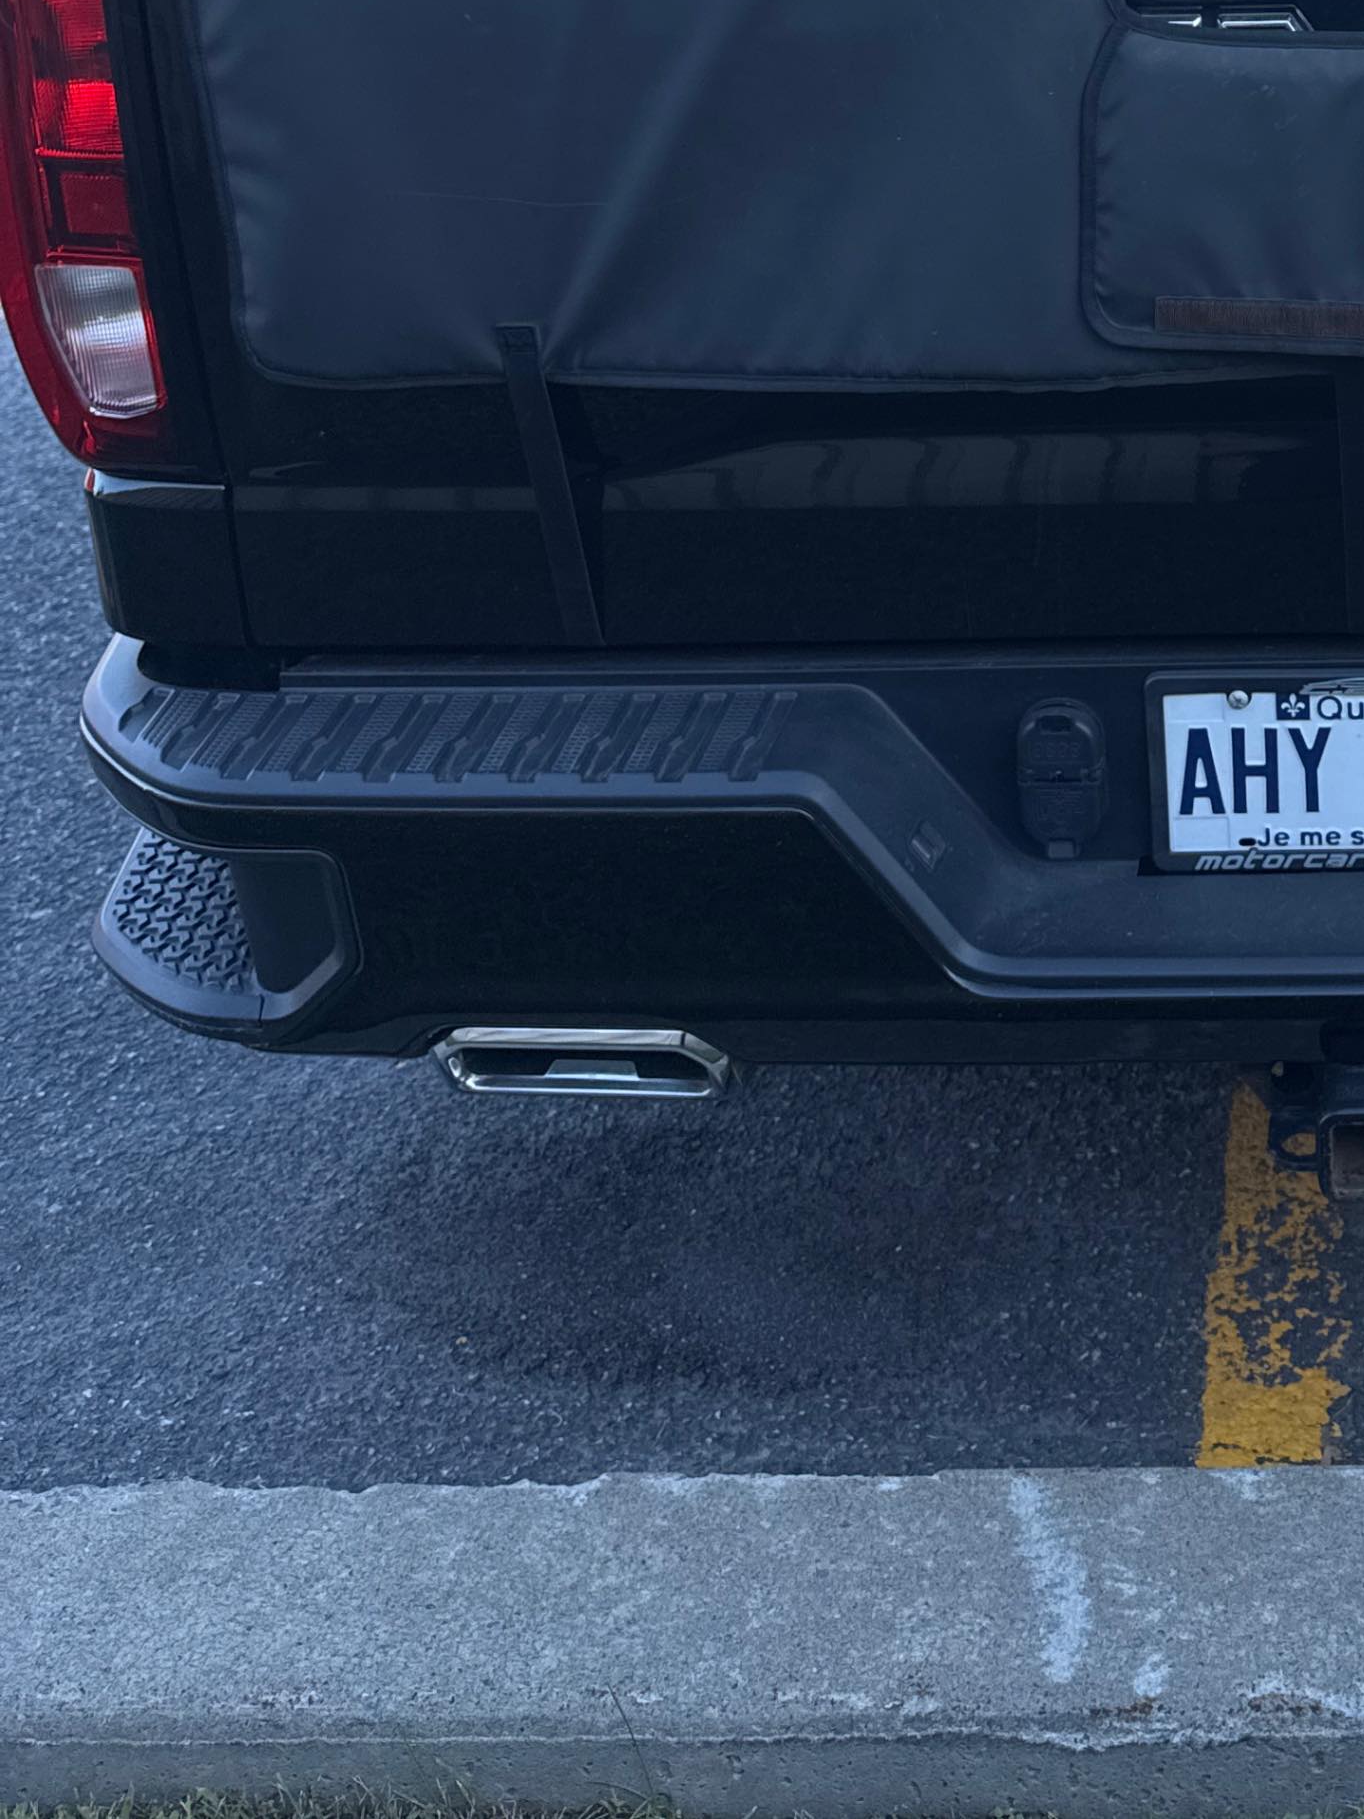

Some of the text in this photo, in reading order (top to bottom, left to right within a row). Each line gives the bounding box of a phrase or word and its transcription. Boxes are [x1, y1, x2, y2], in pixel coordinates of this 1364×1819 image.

[1178, 726, 1333, 815] AHY
[1256, 827, 1290, 846] Je
[1300, 830, 1343, 846] me
